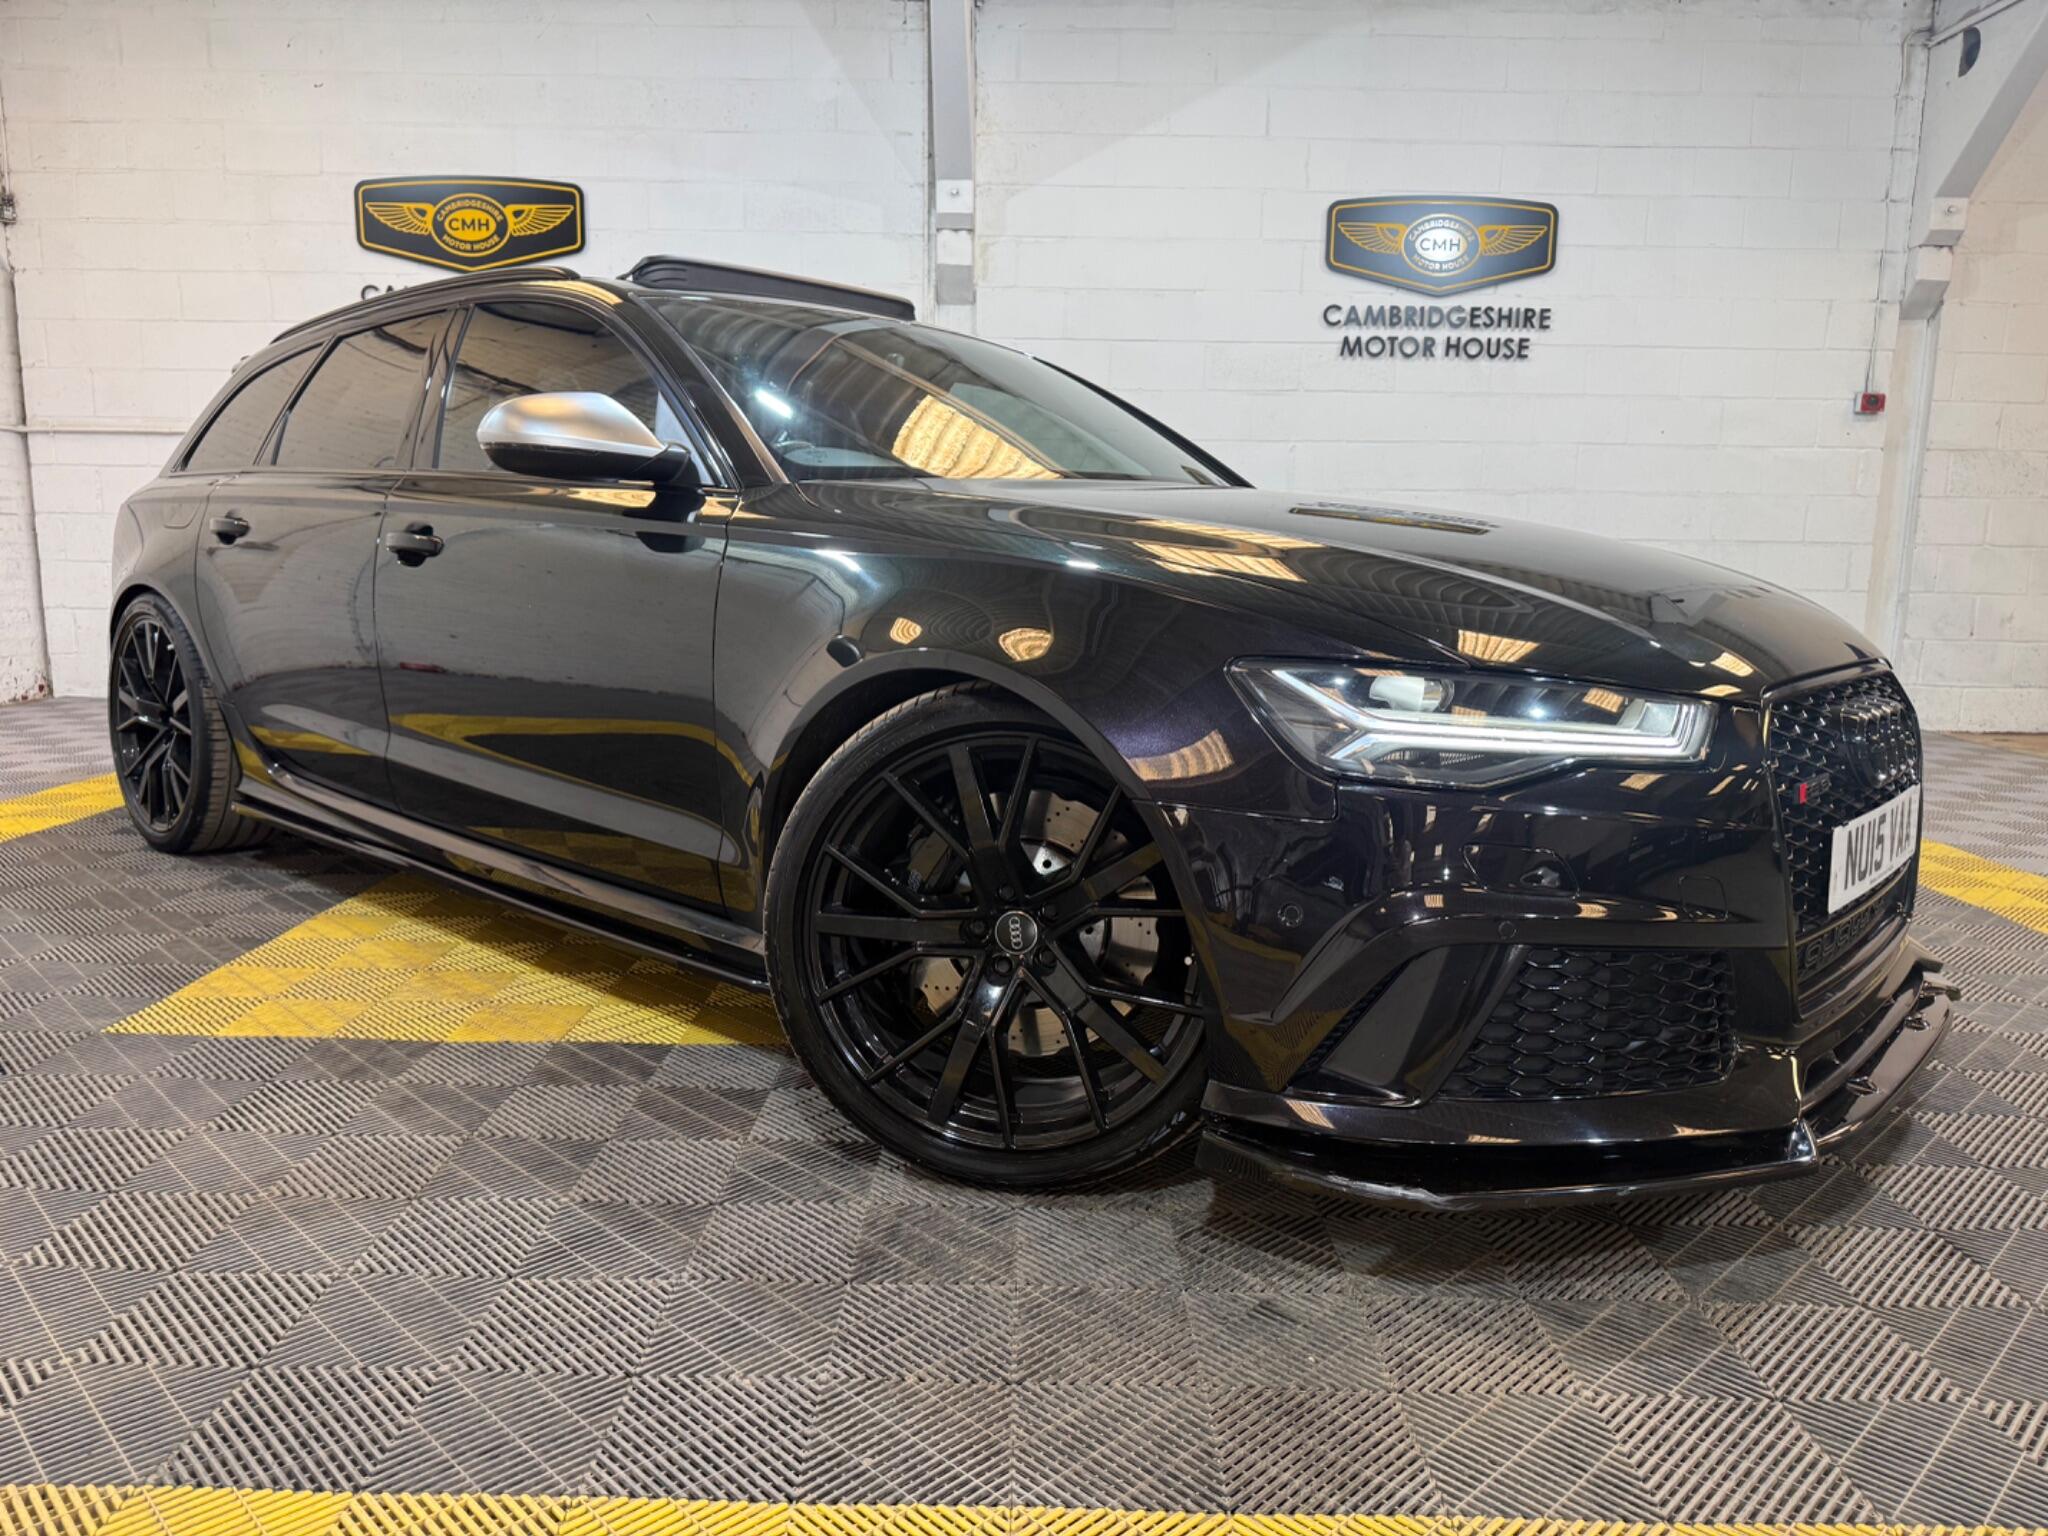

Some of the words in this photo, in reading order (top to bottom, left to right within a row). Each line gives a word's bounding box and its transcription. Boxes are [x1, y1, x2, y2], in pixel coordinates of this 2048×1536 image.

[437, 199, 504, 221] CAMBRIDGESHIRE
[448, 218, 490, 231] CMH
[442, 233, 471, 250] MOTOR
[473, 234, 500, 250] HOUSE
[1420, 237, 1460, 251] CMH
[1323, 304, 1551, 329] CAMBRIDGESHIRE
[1341, 336, 1435, 358] MOTOR
[1445, 336, 1530, 359] HOUSE
[1844, 813, 1887, 890] NU15
